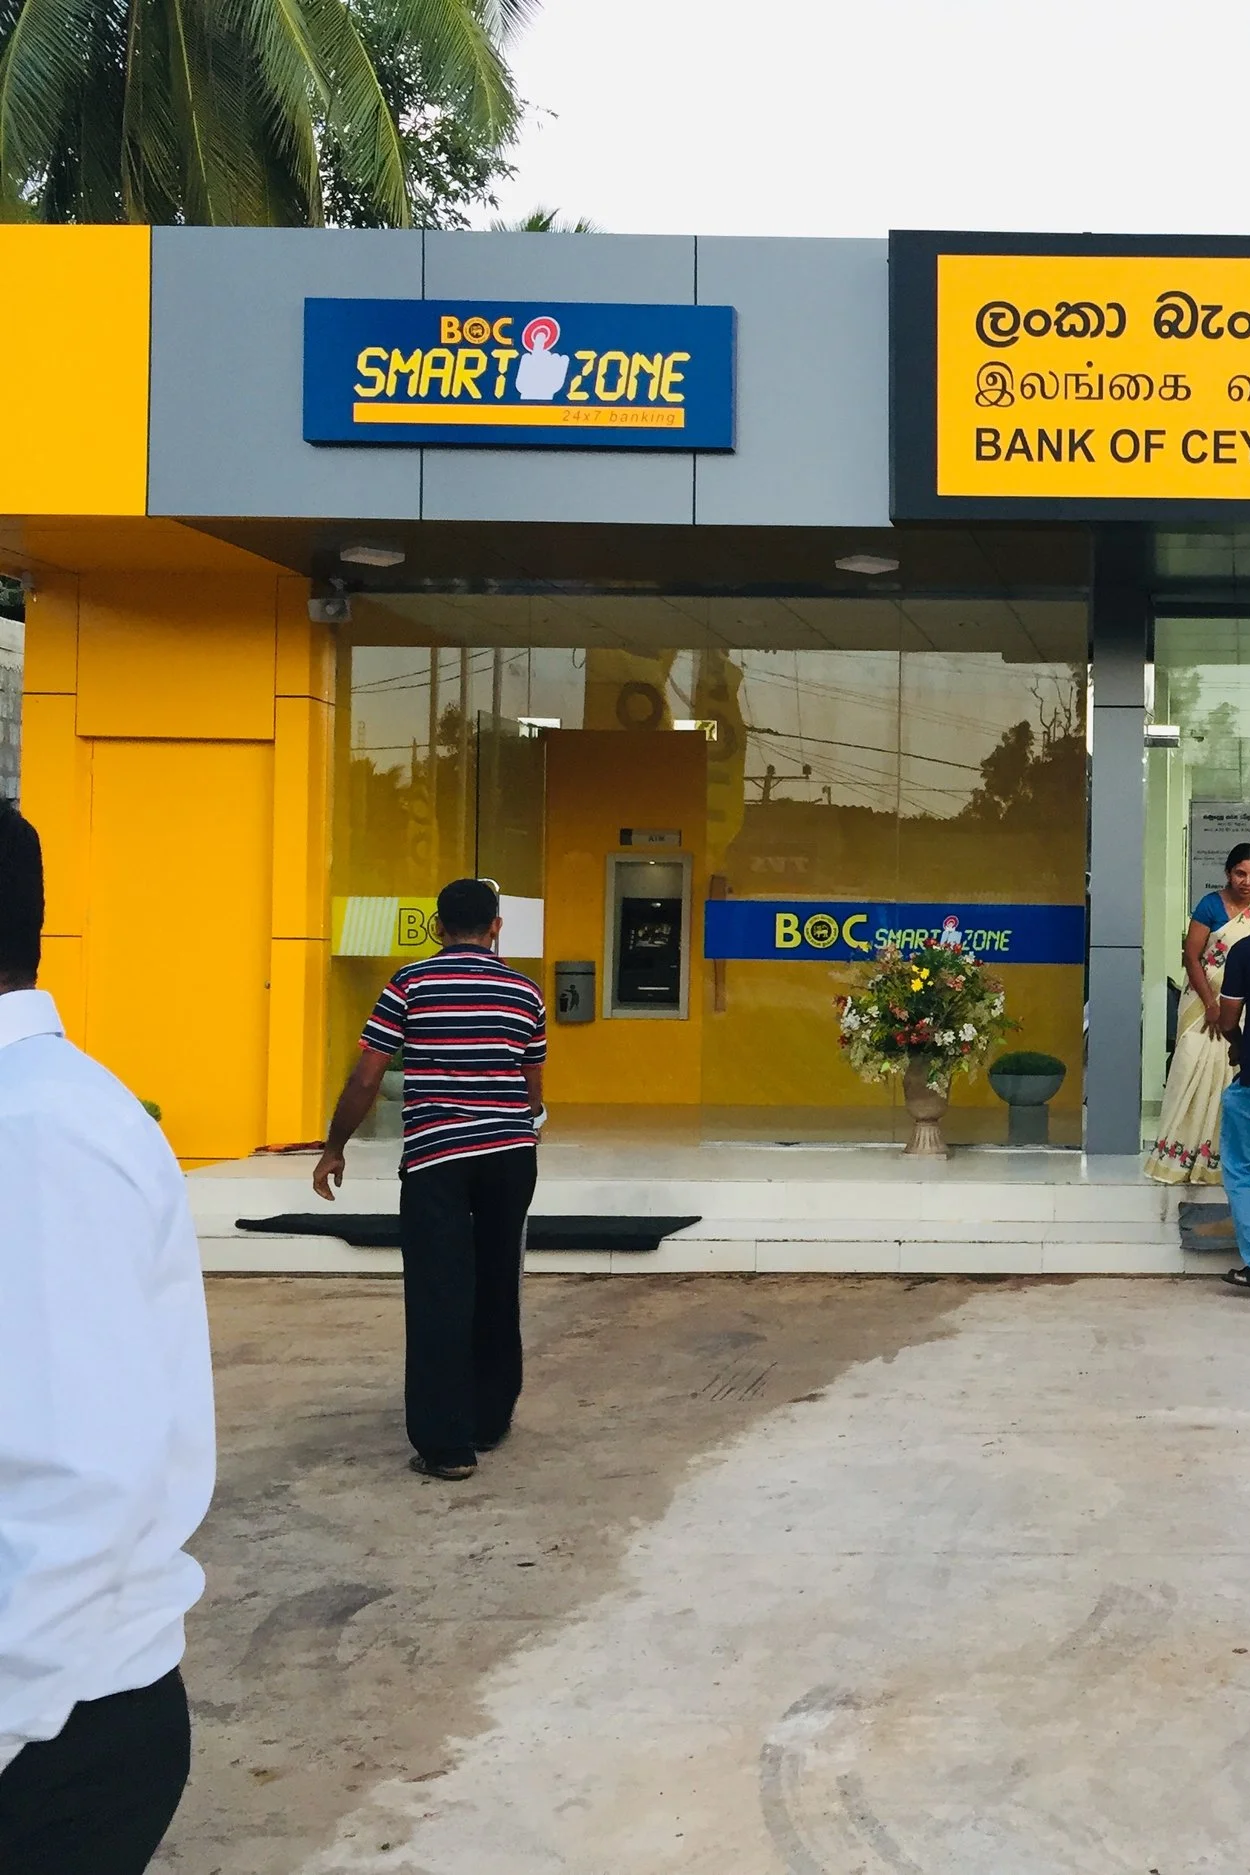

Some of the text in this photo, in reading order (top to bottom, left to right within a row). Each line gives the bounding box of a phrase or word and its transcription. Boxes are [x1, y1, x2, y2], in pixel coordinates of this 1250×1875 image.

[441, 315, 513, 345] BOC
[975, 300, 1127, 348] ලංකා
[353, 346, 691, 403] SMART ZONE
[975, 360, 1191, 408] இலங்கை
[562, 409, 676, 426] 24x7 banking
[975, 427, 1096, 463] BANK
[1110, 428, 1166, 463] OF
[776, 913, 868, 949] BOC
[962, 929, 1012, 951] ZONE
